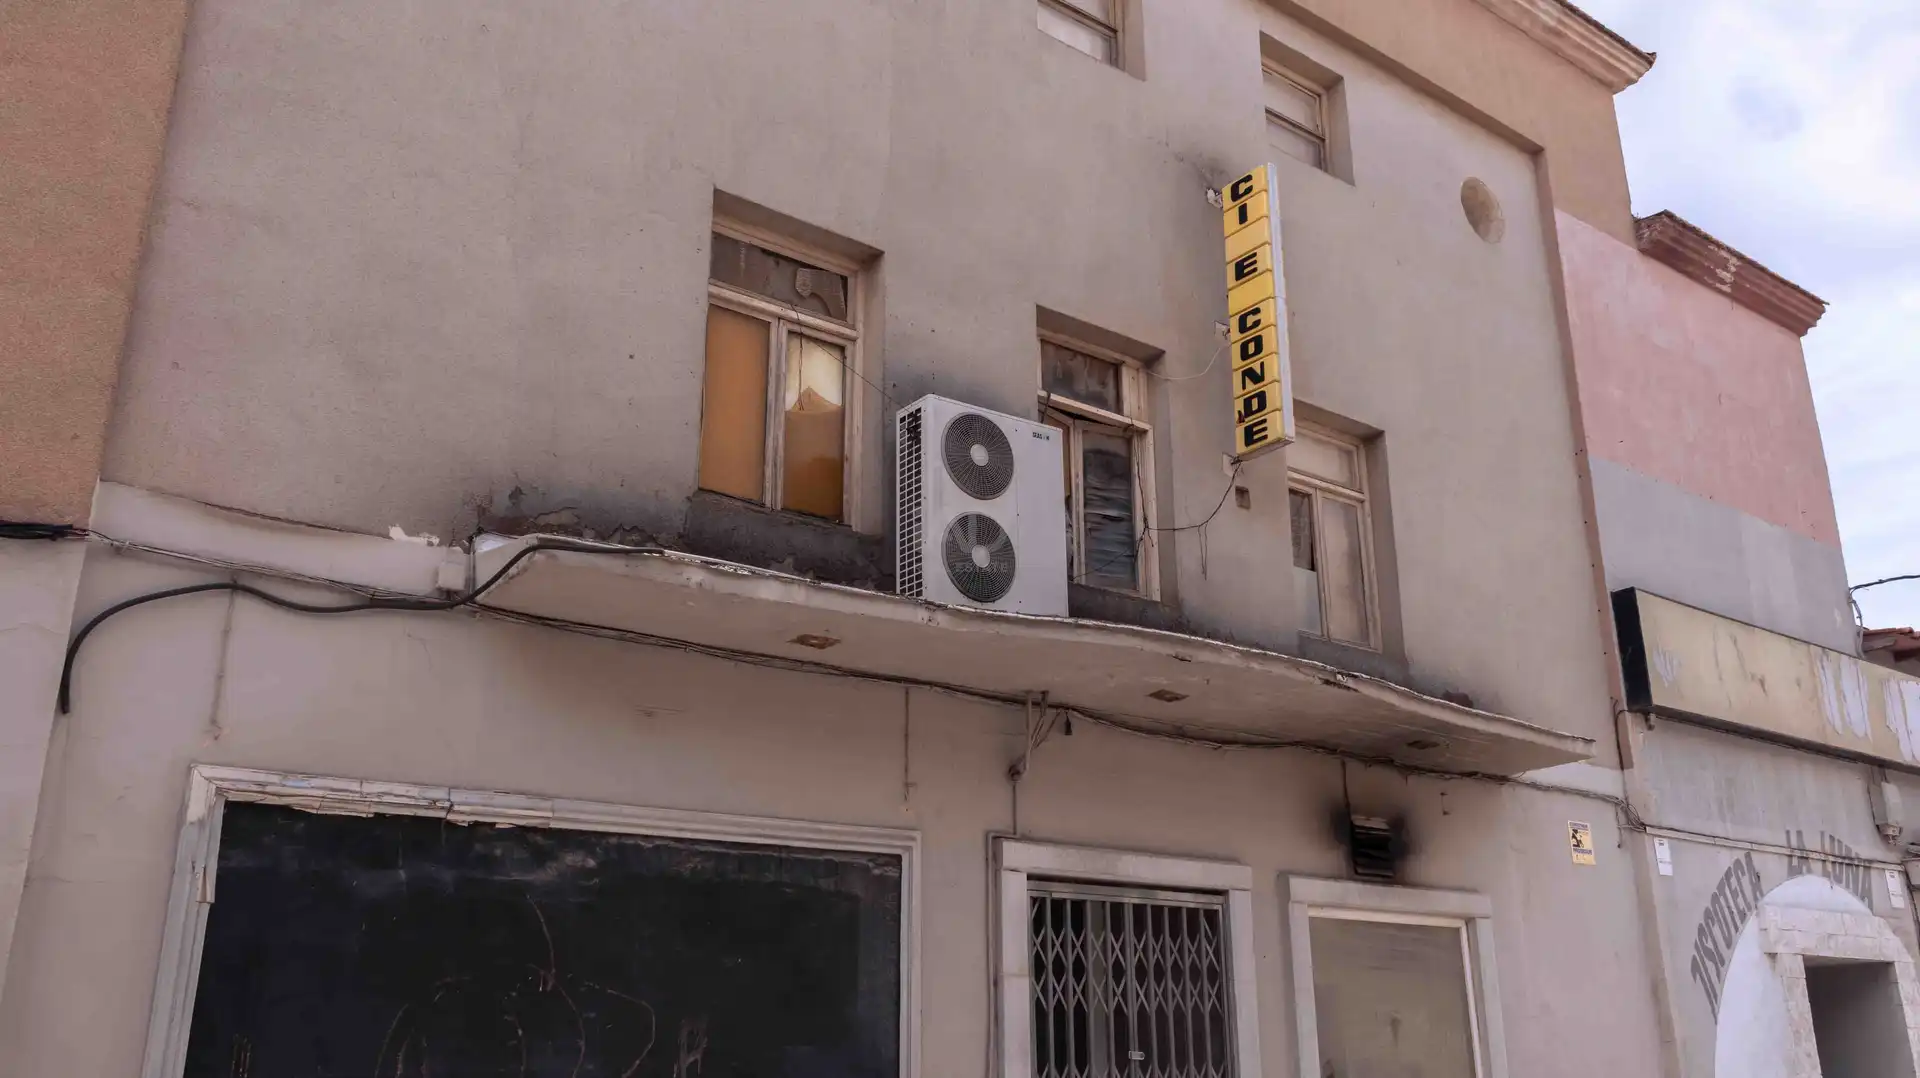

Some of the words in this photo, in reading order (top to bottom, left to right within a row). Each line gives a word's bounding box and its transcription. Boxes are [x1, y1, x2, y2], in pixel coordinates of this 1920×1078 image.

[1238, 307, 1268, 448] CONDE
[1785, 829, 1813, 879] LA
[1820, 830, 1874, 915] LUNA
